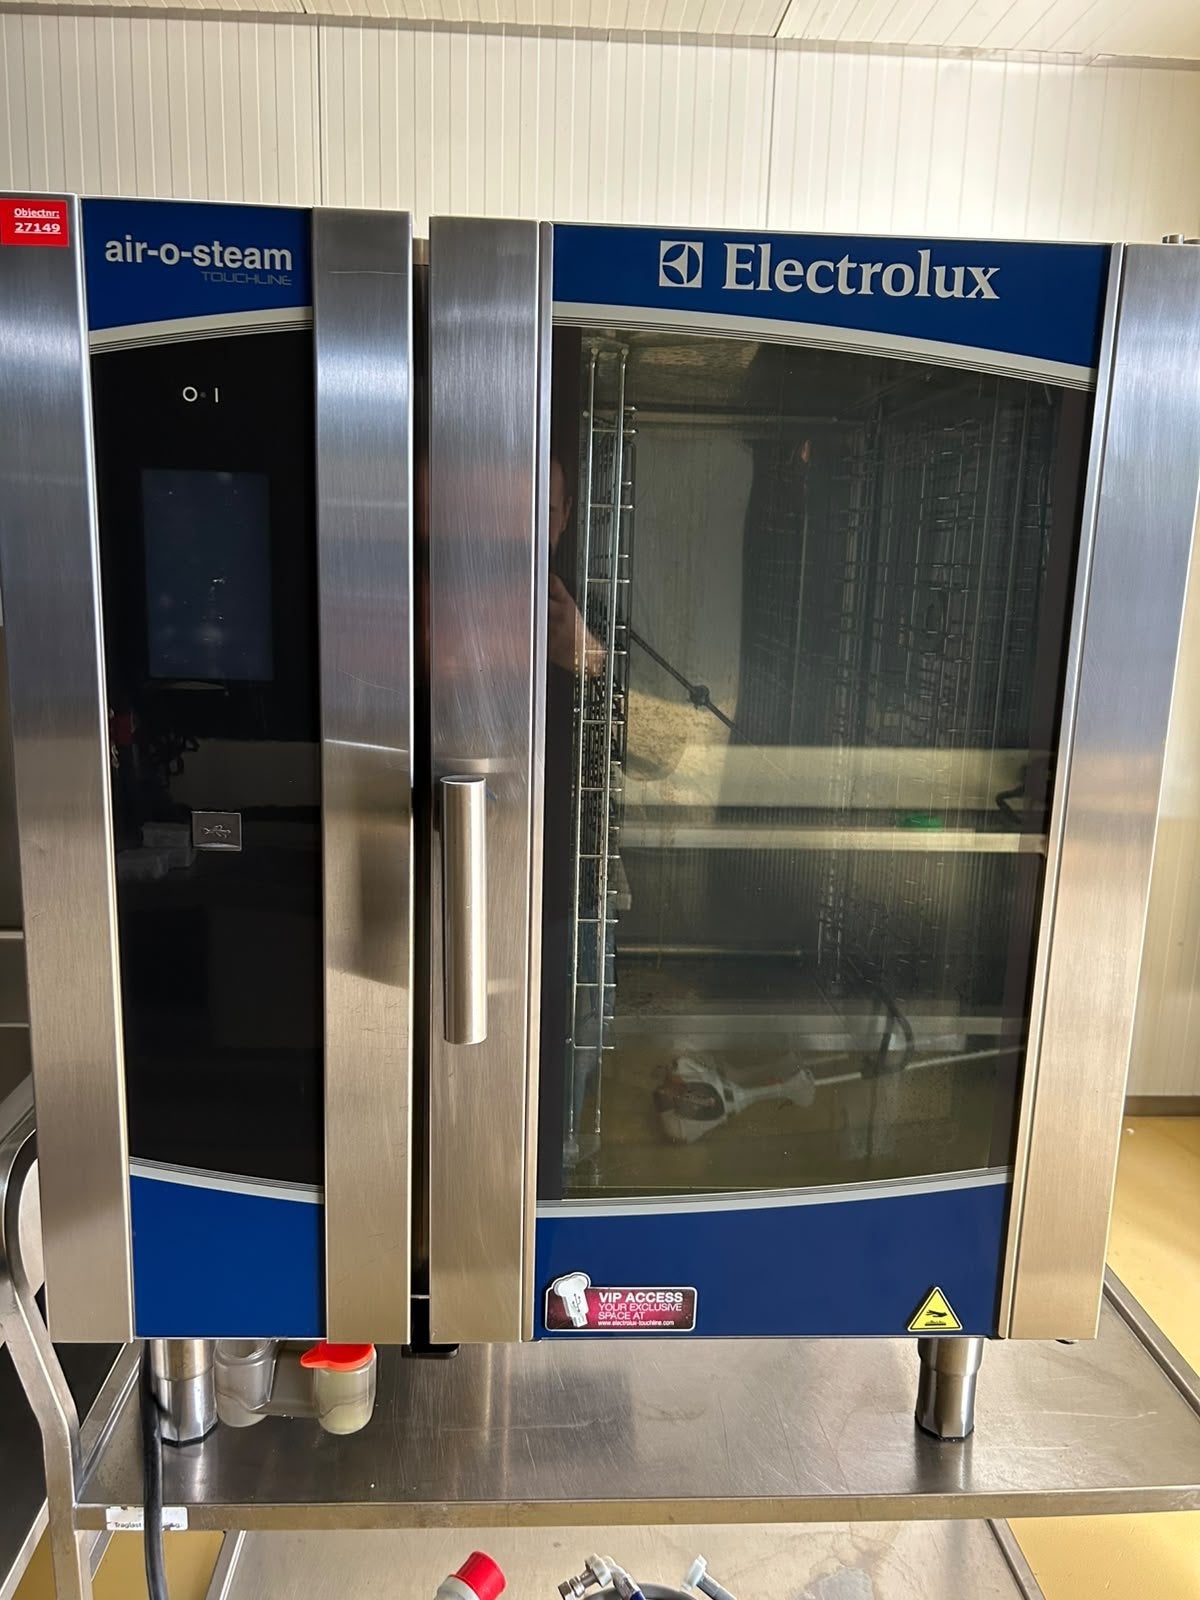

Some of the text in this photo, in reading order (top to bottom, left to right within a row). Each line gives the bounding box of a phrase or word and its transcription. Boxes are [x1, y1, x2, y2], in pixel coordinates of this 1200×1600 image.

[14, 208, 60, 219] Objectnr:
[14, 222, 61, 234] 27149
[105, 234, 292, 271] air-o-steam
[722, 242, 1000, 299] Electrolux
[201, 271, 292, 286] TOUCHLINE
[599, 1292, 683, 1303] VIP ACCESS
[599, 1303, 682, 1312] YOUR EXCLUSIVE
[598, 1312, 645, 1320] SPACE AT
